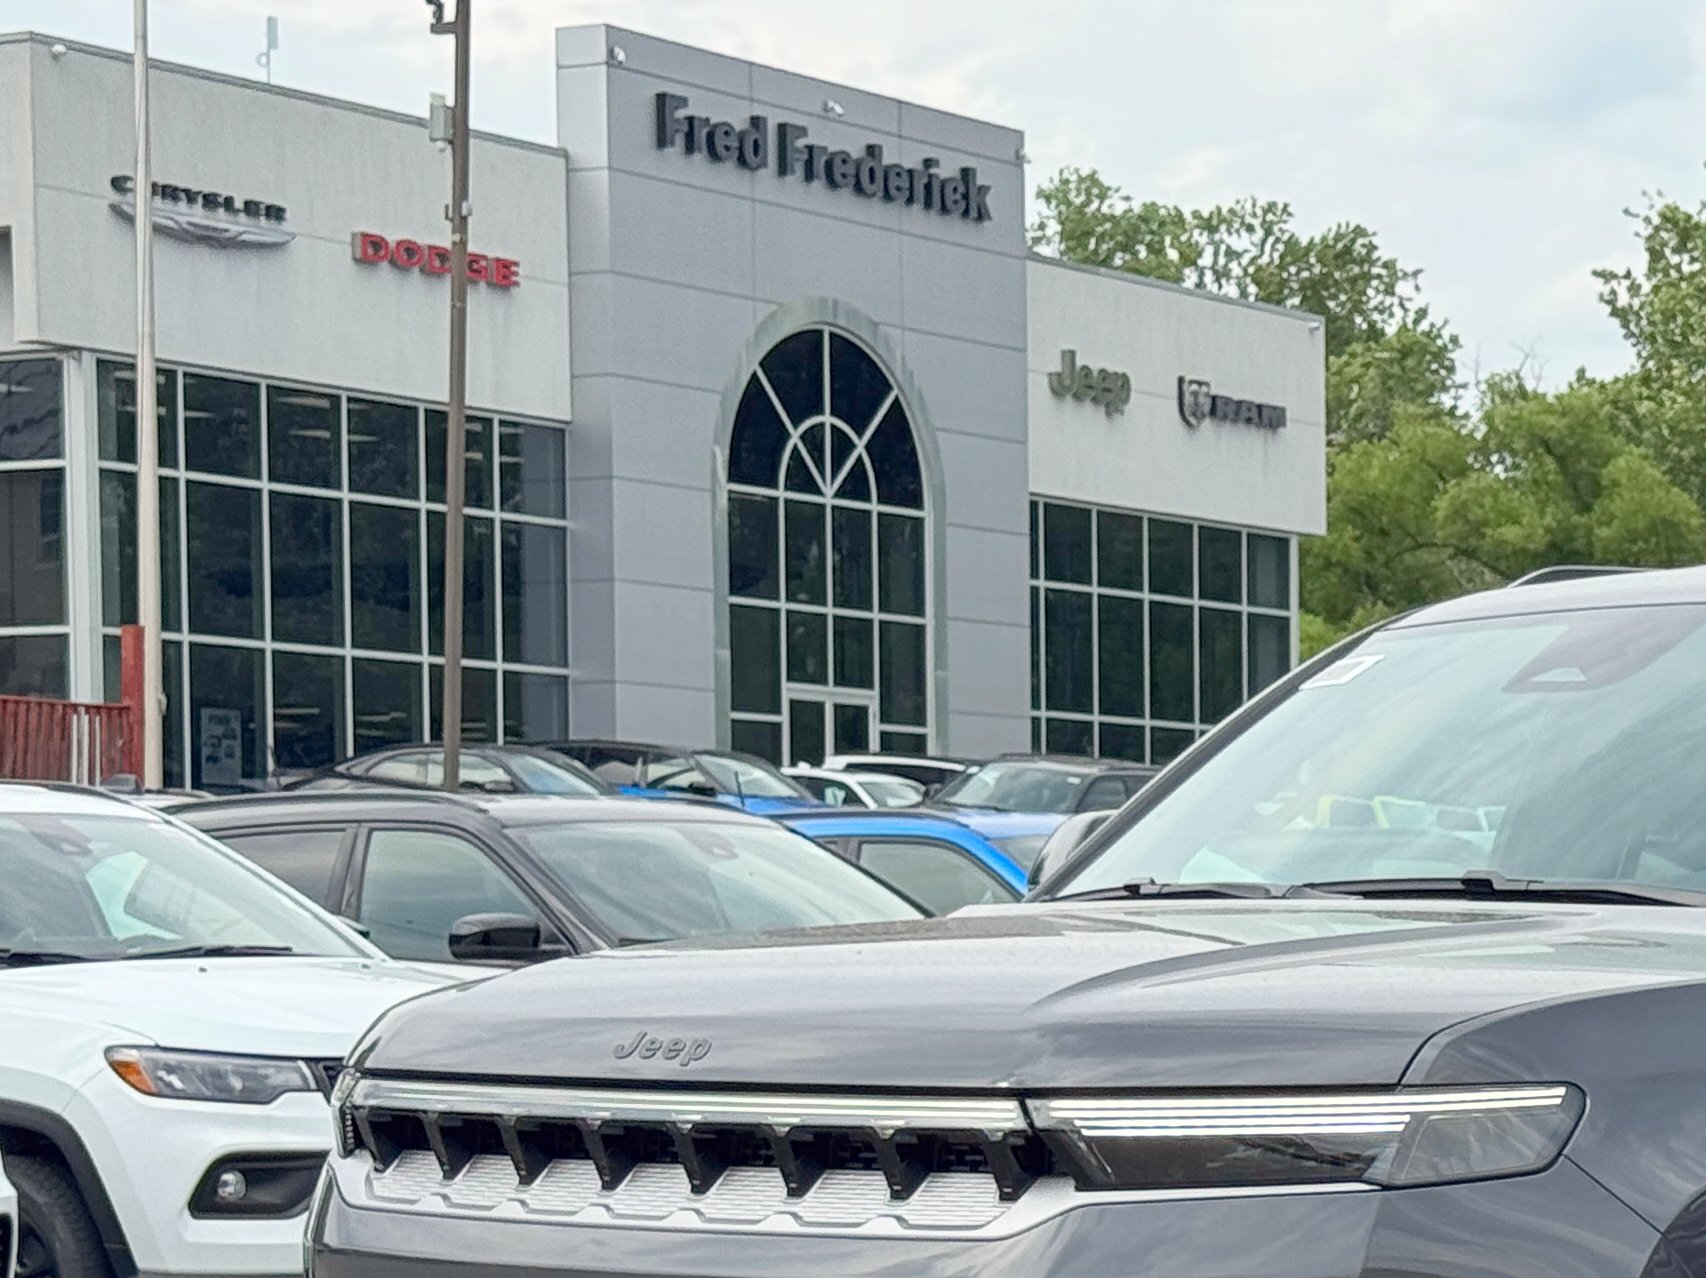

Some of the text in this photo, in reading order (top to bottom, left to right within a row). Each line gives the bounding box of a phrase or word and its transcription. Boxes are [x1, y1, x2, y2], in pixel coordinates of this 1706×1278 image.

[656, 92, 992, 222] Fred Frederick
[111, 175, 288, 222] CRYSLER
[353, 232, 521, 288] DODGE
[1048, 350, 1131, 418] Jeep
[613, 1029, 713, 1067] Jeep
